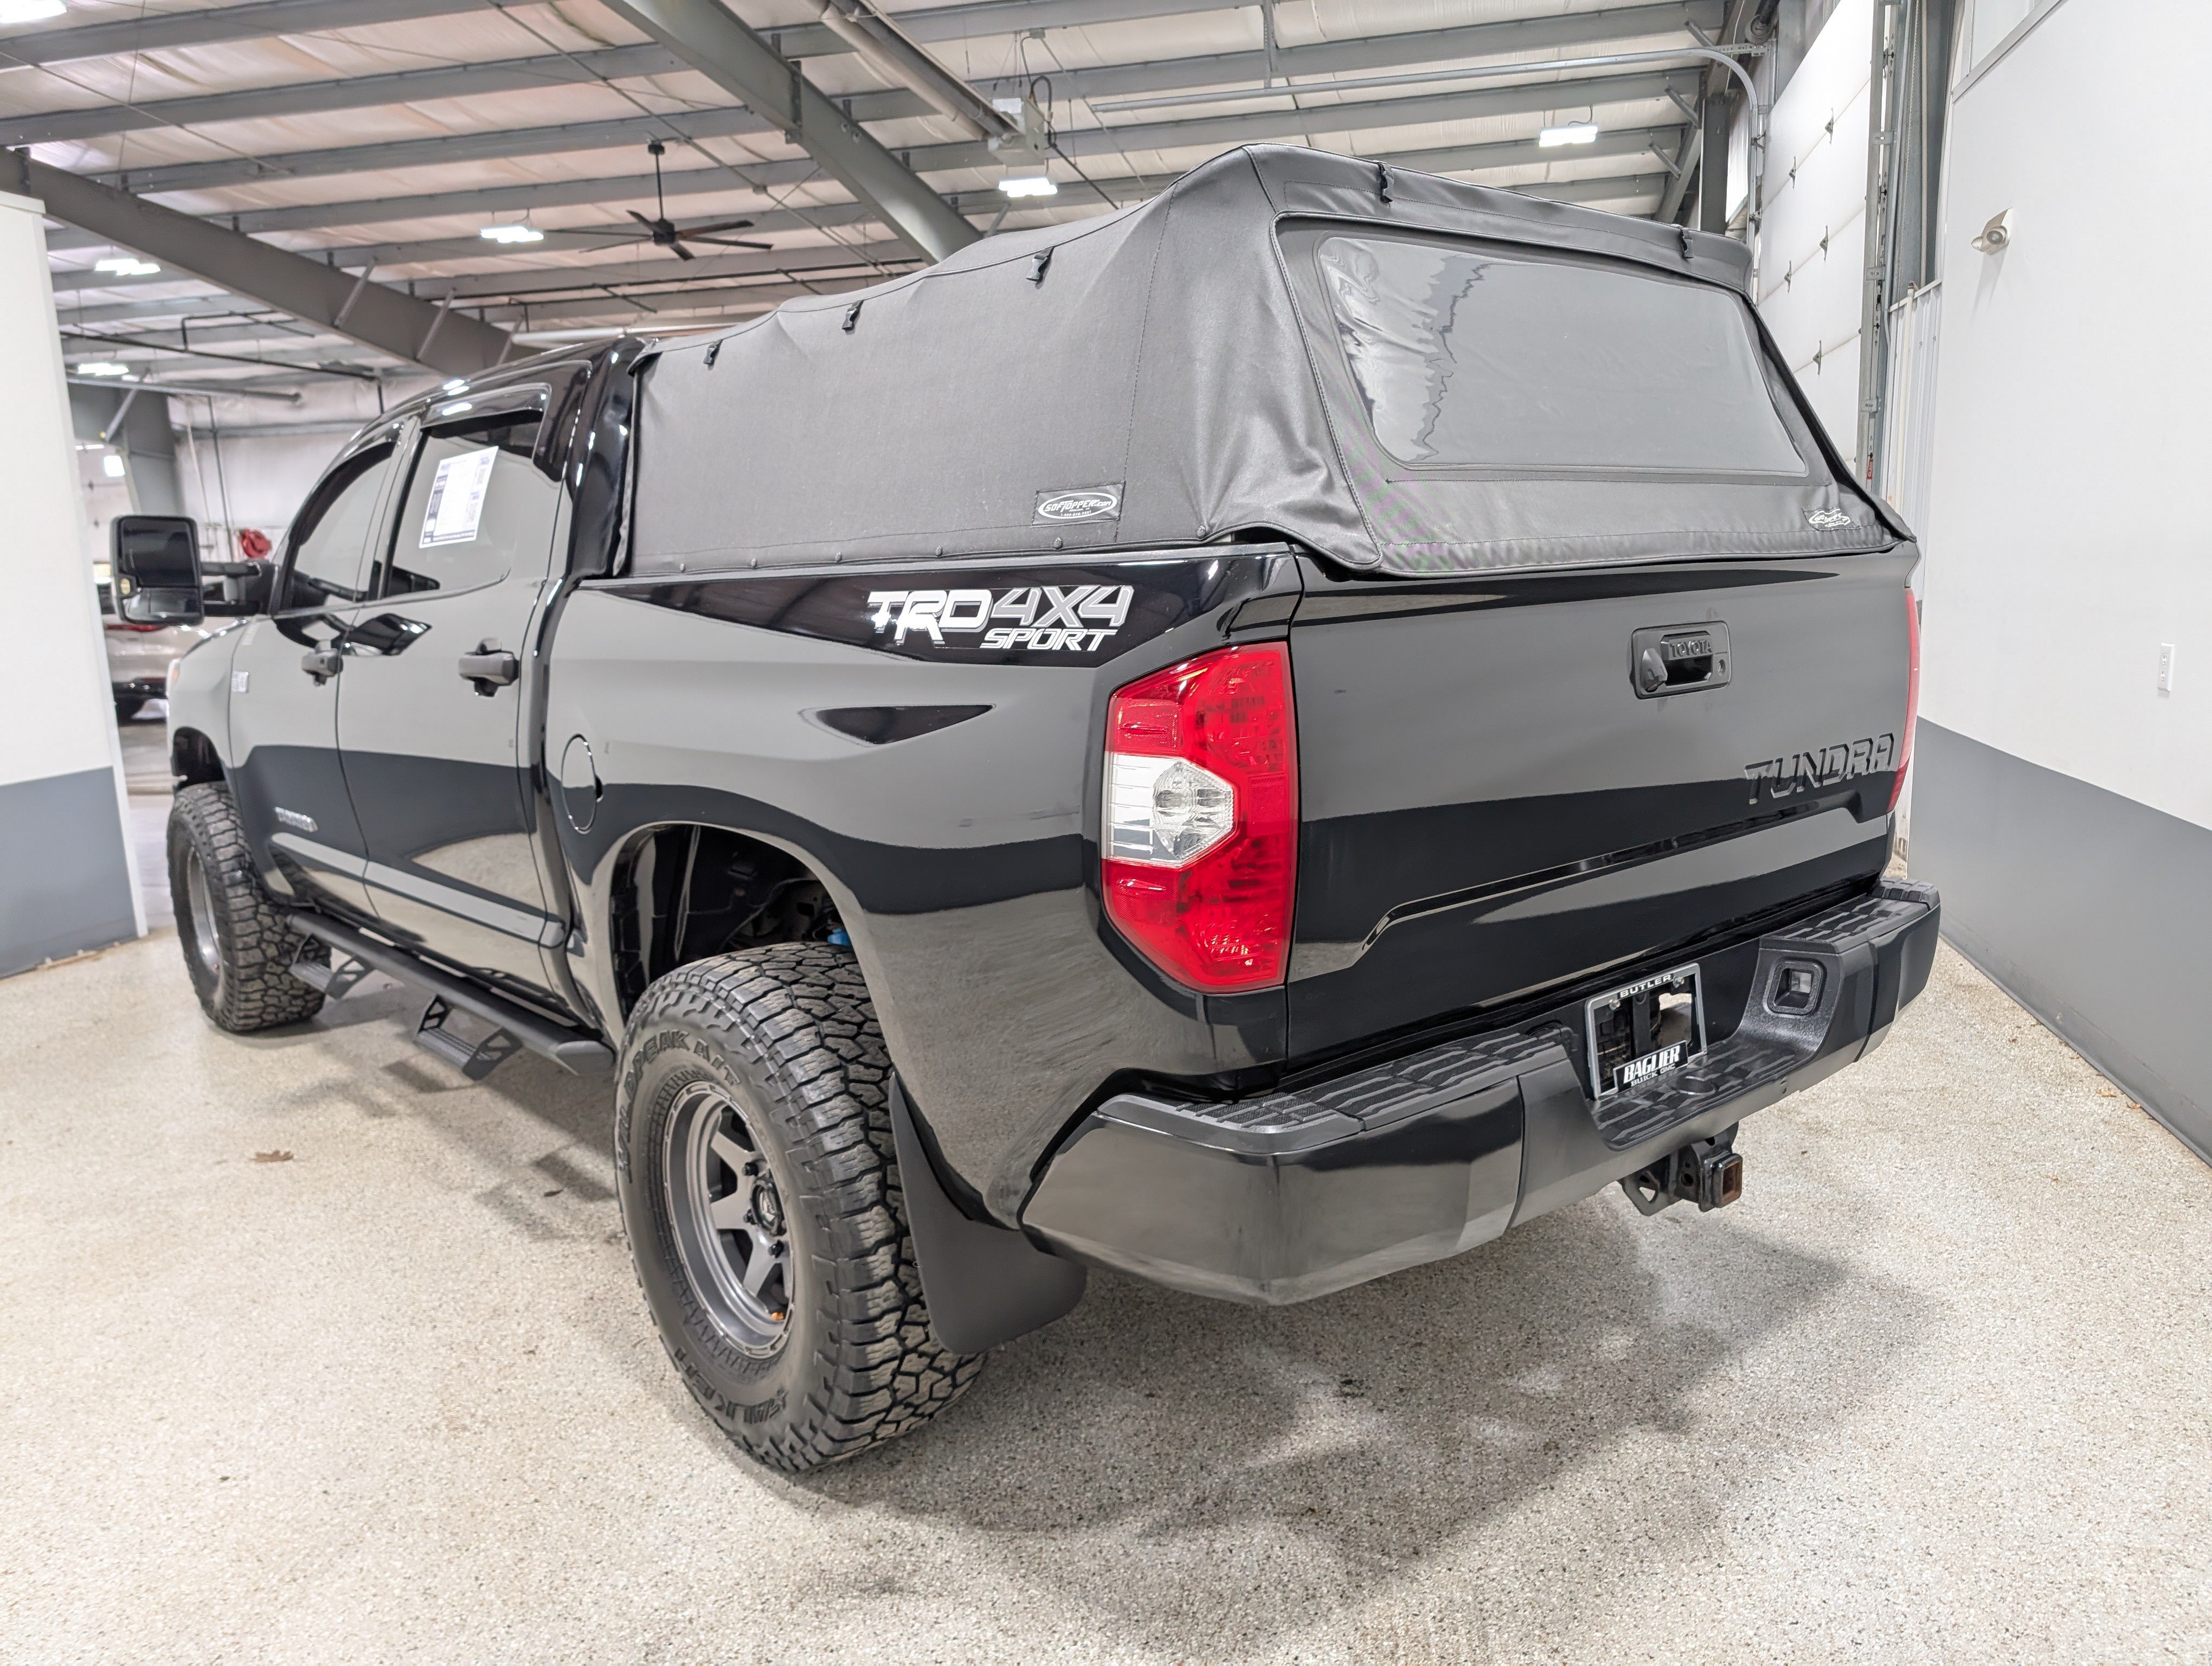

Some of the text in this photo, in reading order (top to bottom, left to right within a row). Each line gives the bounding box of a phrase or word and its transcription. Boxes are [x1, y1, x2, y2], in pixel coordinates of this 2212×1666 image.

[867, 585, 1135, 646] TRD 4X4
[979, 627, 1117, 651] SPORT
[1669, 639, 1713, 658] TOYOTA
[1744, 733, 1894, 805] TUNDRA
[1619, 974, 1671, 998] BUTLER
[1623, 1045, 1681, 1084] BAGLIER
[1630, 1063, 1676, 1087] BUICK GMC
